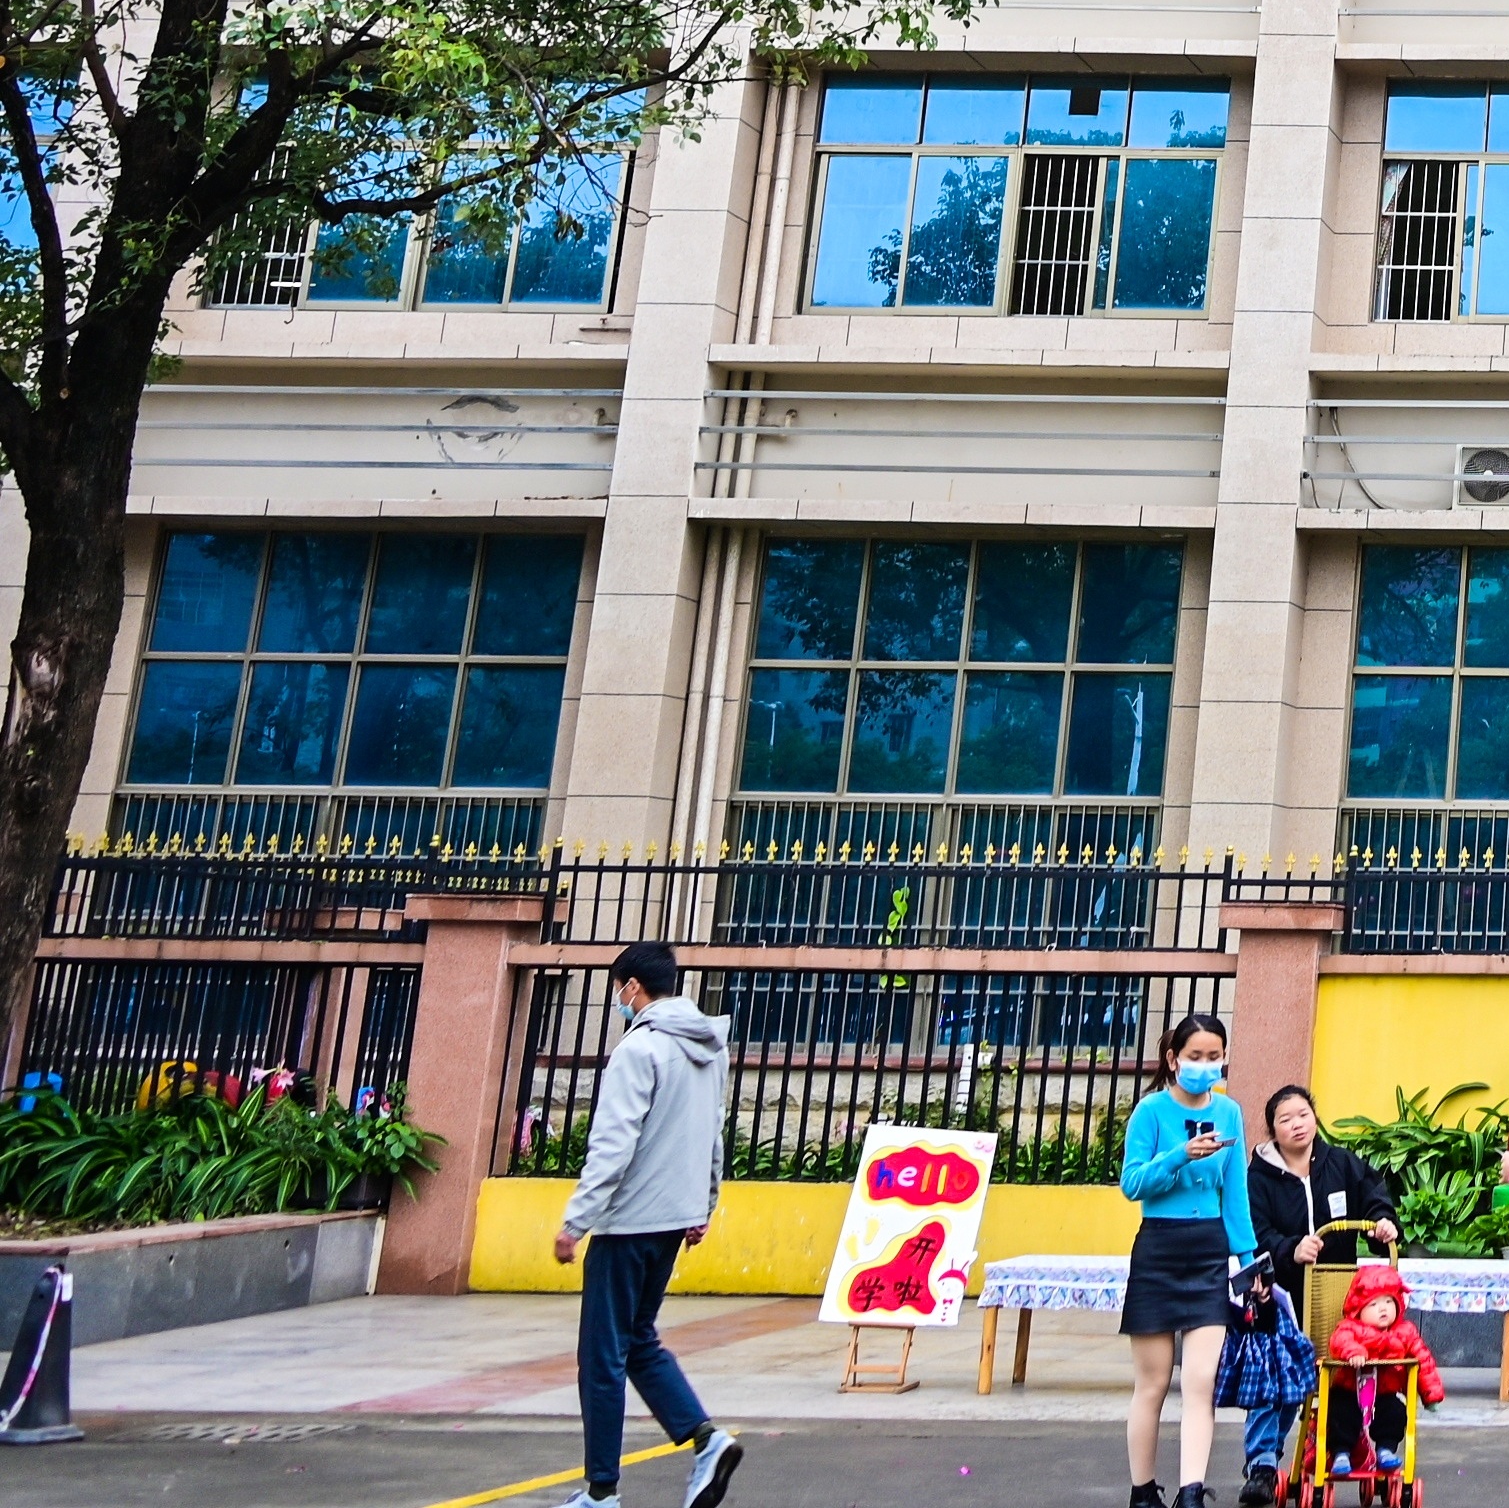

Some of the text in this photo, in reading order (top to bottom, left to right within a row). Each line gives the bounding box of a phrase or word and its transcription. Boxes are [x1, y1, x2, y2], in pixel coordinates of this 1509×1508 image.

[876, 1160, 969, 1196] hello
[907, 1237, 937, 1266] 开
[856, 1277, 922, 1311] 学啦
